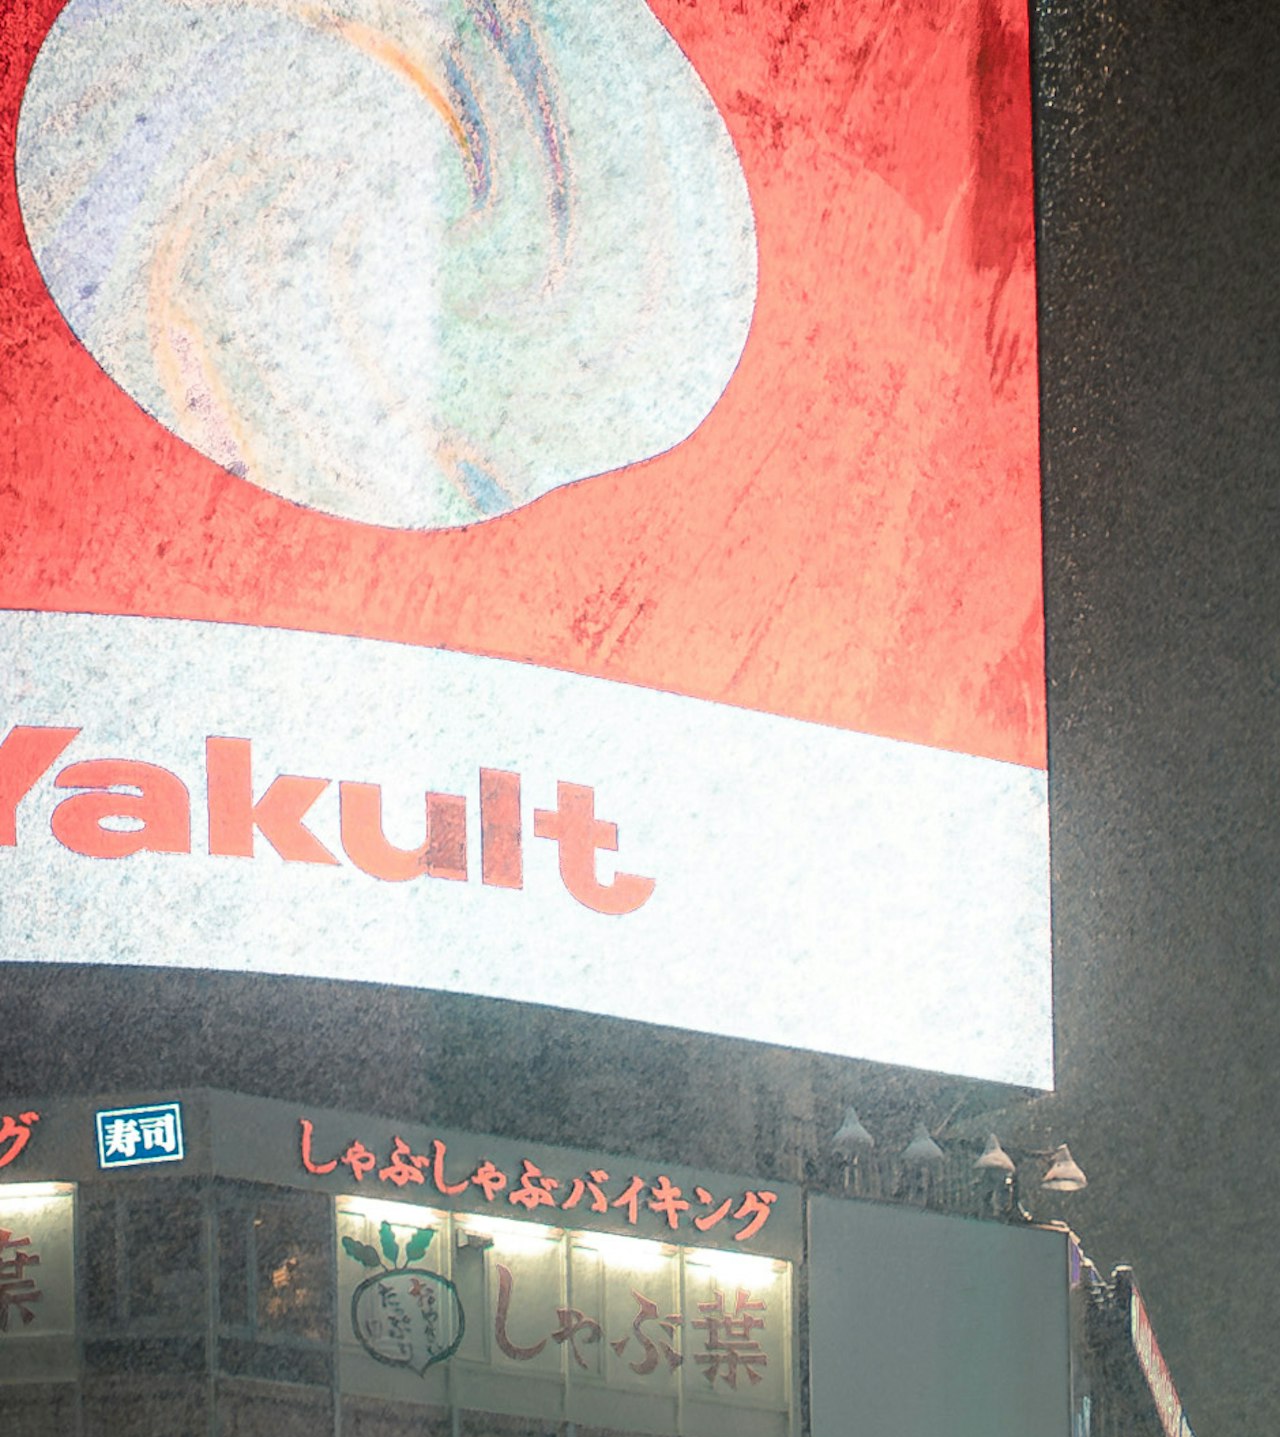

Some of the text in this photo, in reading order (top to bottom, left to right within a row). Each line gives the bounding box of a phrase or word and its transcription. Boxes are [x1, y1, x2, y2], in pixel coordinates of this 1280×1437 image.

[0, 725, 657, 916] Yakult
[105, 1113, 175, 1157] 寿司
[298, 1118, 777, 1241] しゃぶしゃぶバイキング
[496, 1263, 767, 1389] しゃぶ葉
